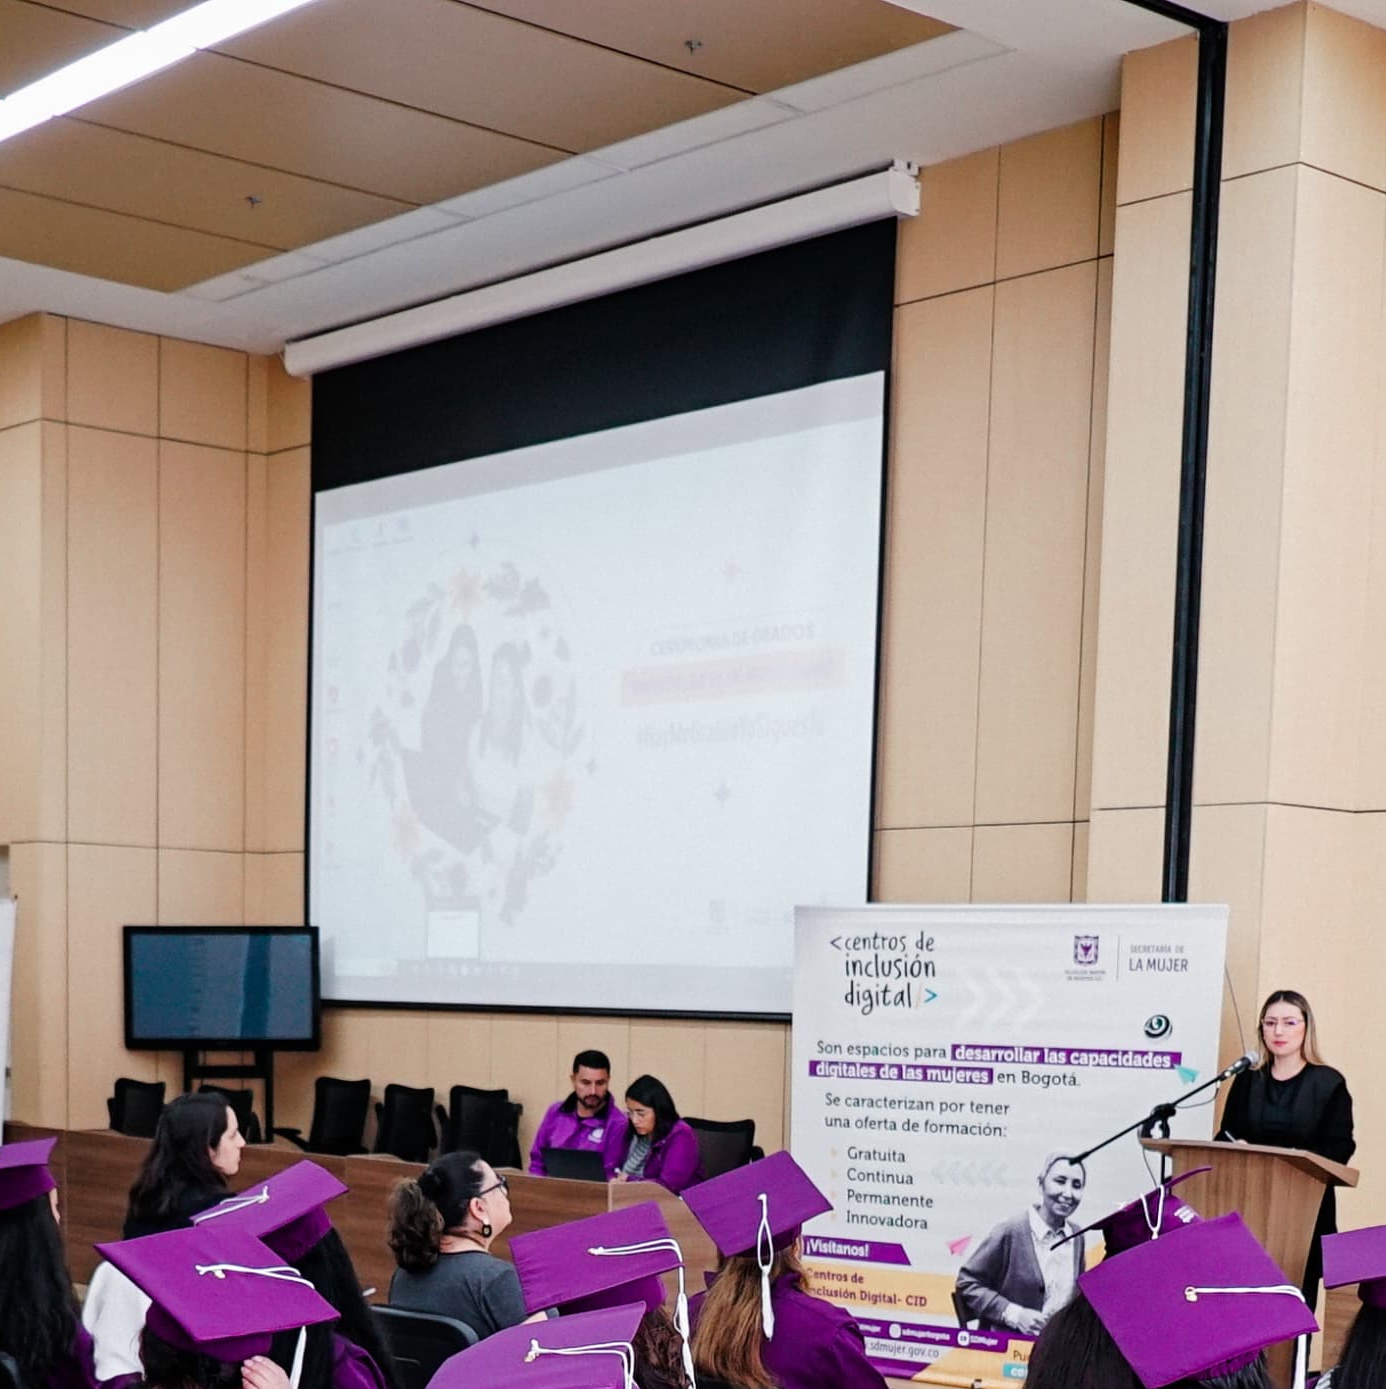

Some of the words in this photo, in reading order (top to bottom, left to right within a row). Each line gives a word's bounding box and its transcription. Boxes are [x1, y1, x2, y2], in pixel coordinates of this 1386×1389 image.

[915, 930, 935, 952] de
[1130, 944, 1172, 954] SECRETARÍA
[1174, 945, 1184, 954] DE
[845, 952, 936, 979] inclusión
[1129, 958, 1143, 972] LA
[1146, 958, 1189, 972] MUJER
[844, 979, 912, 1015] digital
[817, 1040, 842, 1055] Son
[847, 1042, 910, 1059] espacios
[914, 1047, 947, 1061] para
[955, 1046, 1040, 1063] desarrollar
[1043, 1048, 1066, 1064] las
[1070, 1051, 1171, 1068] capacidades
[816, 1061, 877, 1079] digitales
[879, 1064, 898, 1080] de
[902, 1065, 924, 1081] las
[927, 1068, 989, 1085] mujeres
[997, 1072, 1016, 1084] en
[1021, 1071, 1081, 1088] Bogotá.
[825, 1092, 841, 1106] Se
[844, 1094, 935, 1111] caracterizan
[939, 1100, 964, 1115] por
[970, 1101, 1010, 1115] tener
[825, 1116, 850, 1129] una
[854, 1116, 897, 1131] oferta
[901, 1118, 919, 1132] de
[924, 1120, 1008, 1137] formación:
[847, 1146, 906, 1163] Gratuita
[846, 1167, 914, 1185] Continua
[847, 1188, 934, 1208] Permanente
[846, 1210, 928, 1229] Innovadora
[851, 1271, 864, 1284] de
[905, 1295, 928, 1307] CID
